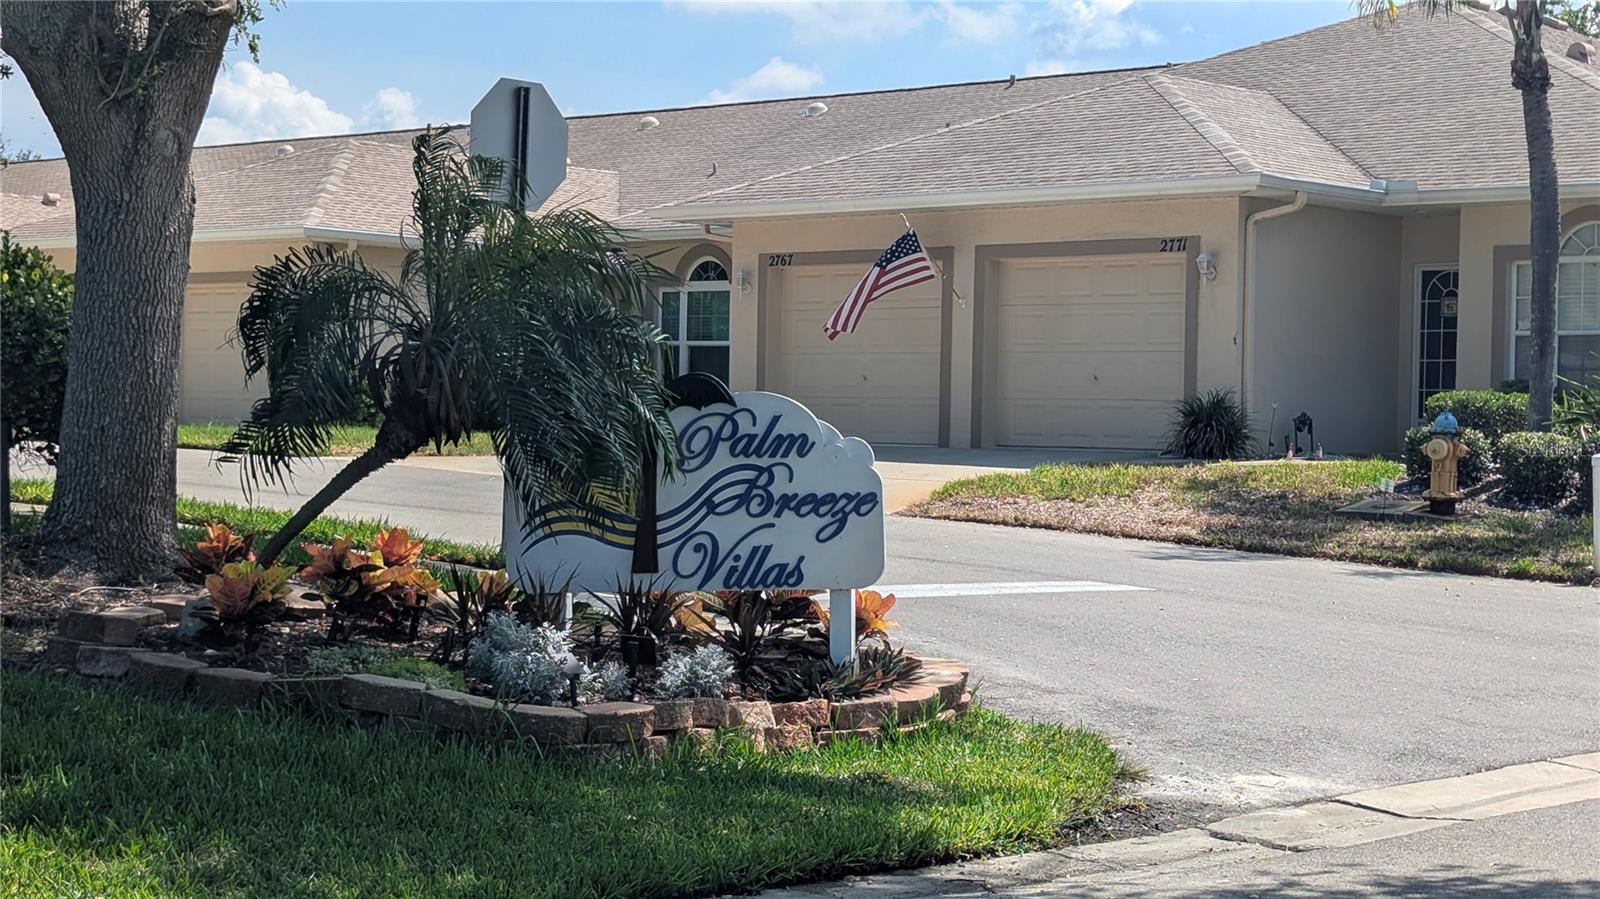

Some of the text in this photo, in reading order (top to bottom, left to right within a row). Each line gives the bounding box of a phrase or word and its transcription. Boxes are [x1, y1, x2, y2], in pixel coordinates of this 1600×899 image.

[768, 254, 794, 267] 2767
[1159, 238, 1188, 252] 2771
[677, 407, 816, 473] Palm
[705, 462, 880, 543] Breeze
[672, 523, 806, 590] Villas
